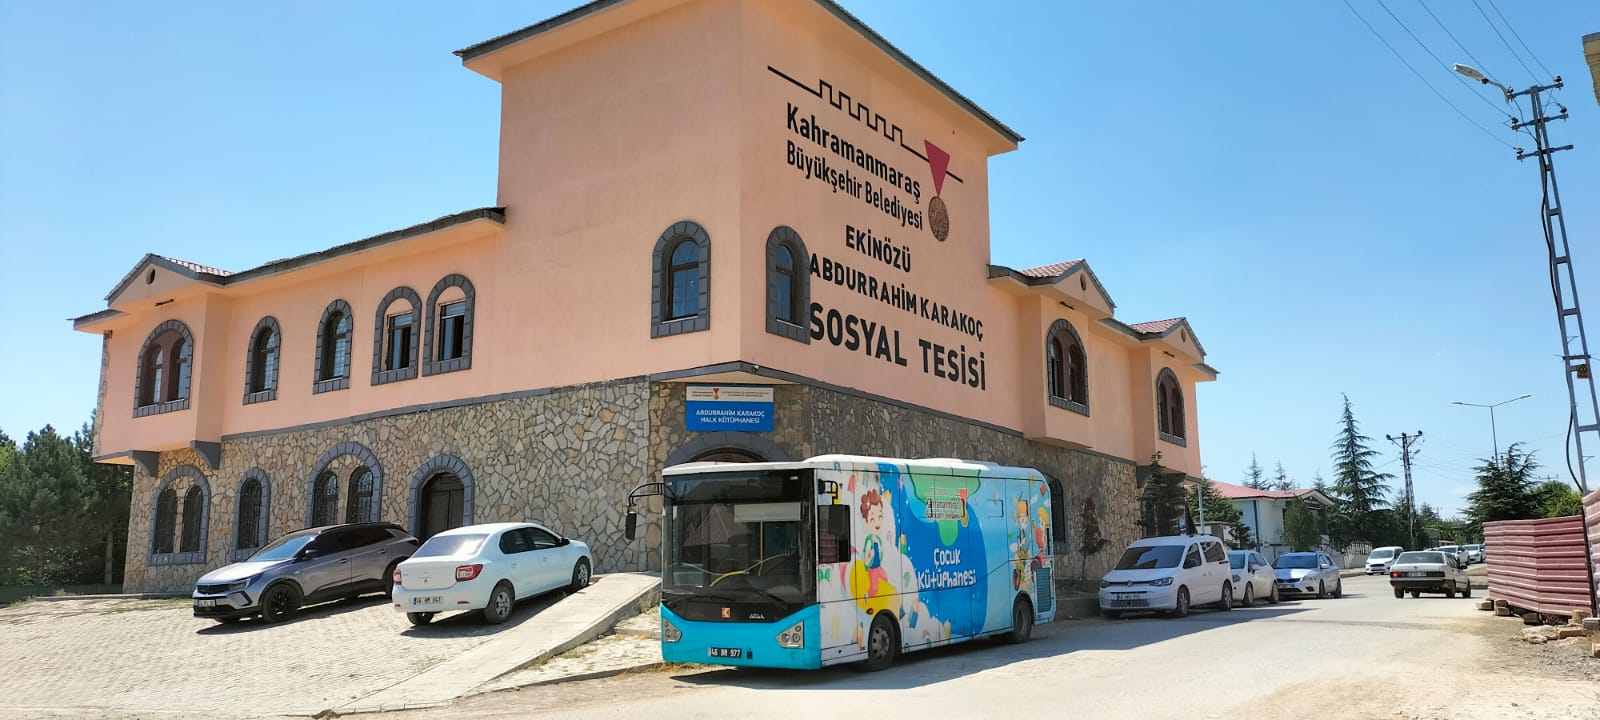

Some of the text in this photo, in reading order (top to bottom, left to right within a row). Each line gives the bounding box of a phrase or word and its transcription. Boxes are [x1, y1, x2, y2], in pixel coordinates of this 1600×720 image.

[786, 102, 921, 205] Kahramanmaraş
[786, 139, 923, 231] Büyükşehir Belediyesi
[845, 224, 911, 273] EKİNÖZÜ
[809, 253, 984, 342] ABDURRAHİM KARAKOÇ
[809, 301, 986, 391] SOSYAL TESİSİ
[718, 416, 760, 424] KÜTÜPHANESİ
[736, 410, 765, 418] KARAKOÇ
[711, 648, 718, 656] 46
[730, 649, 740, 657] 977
